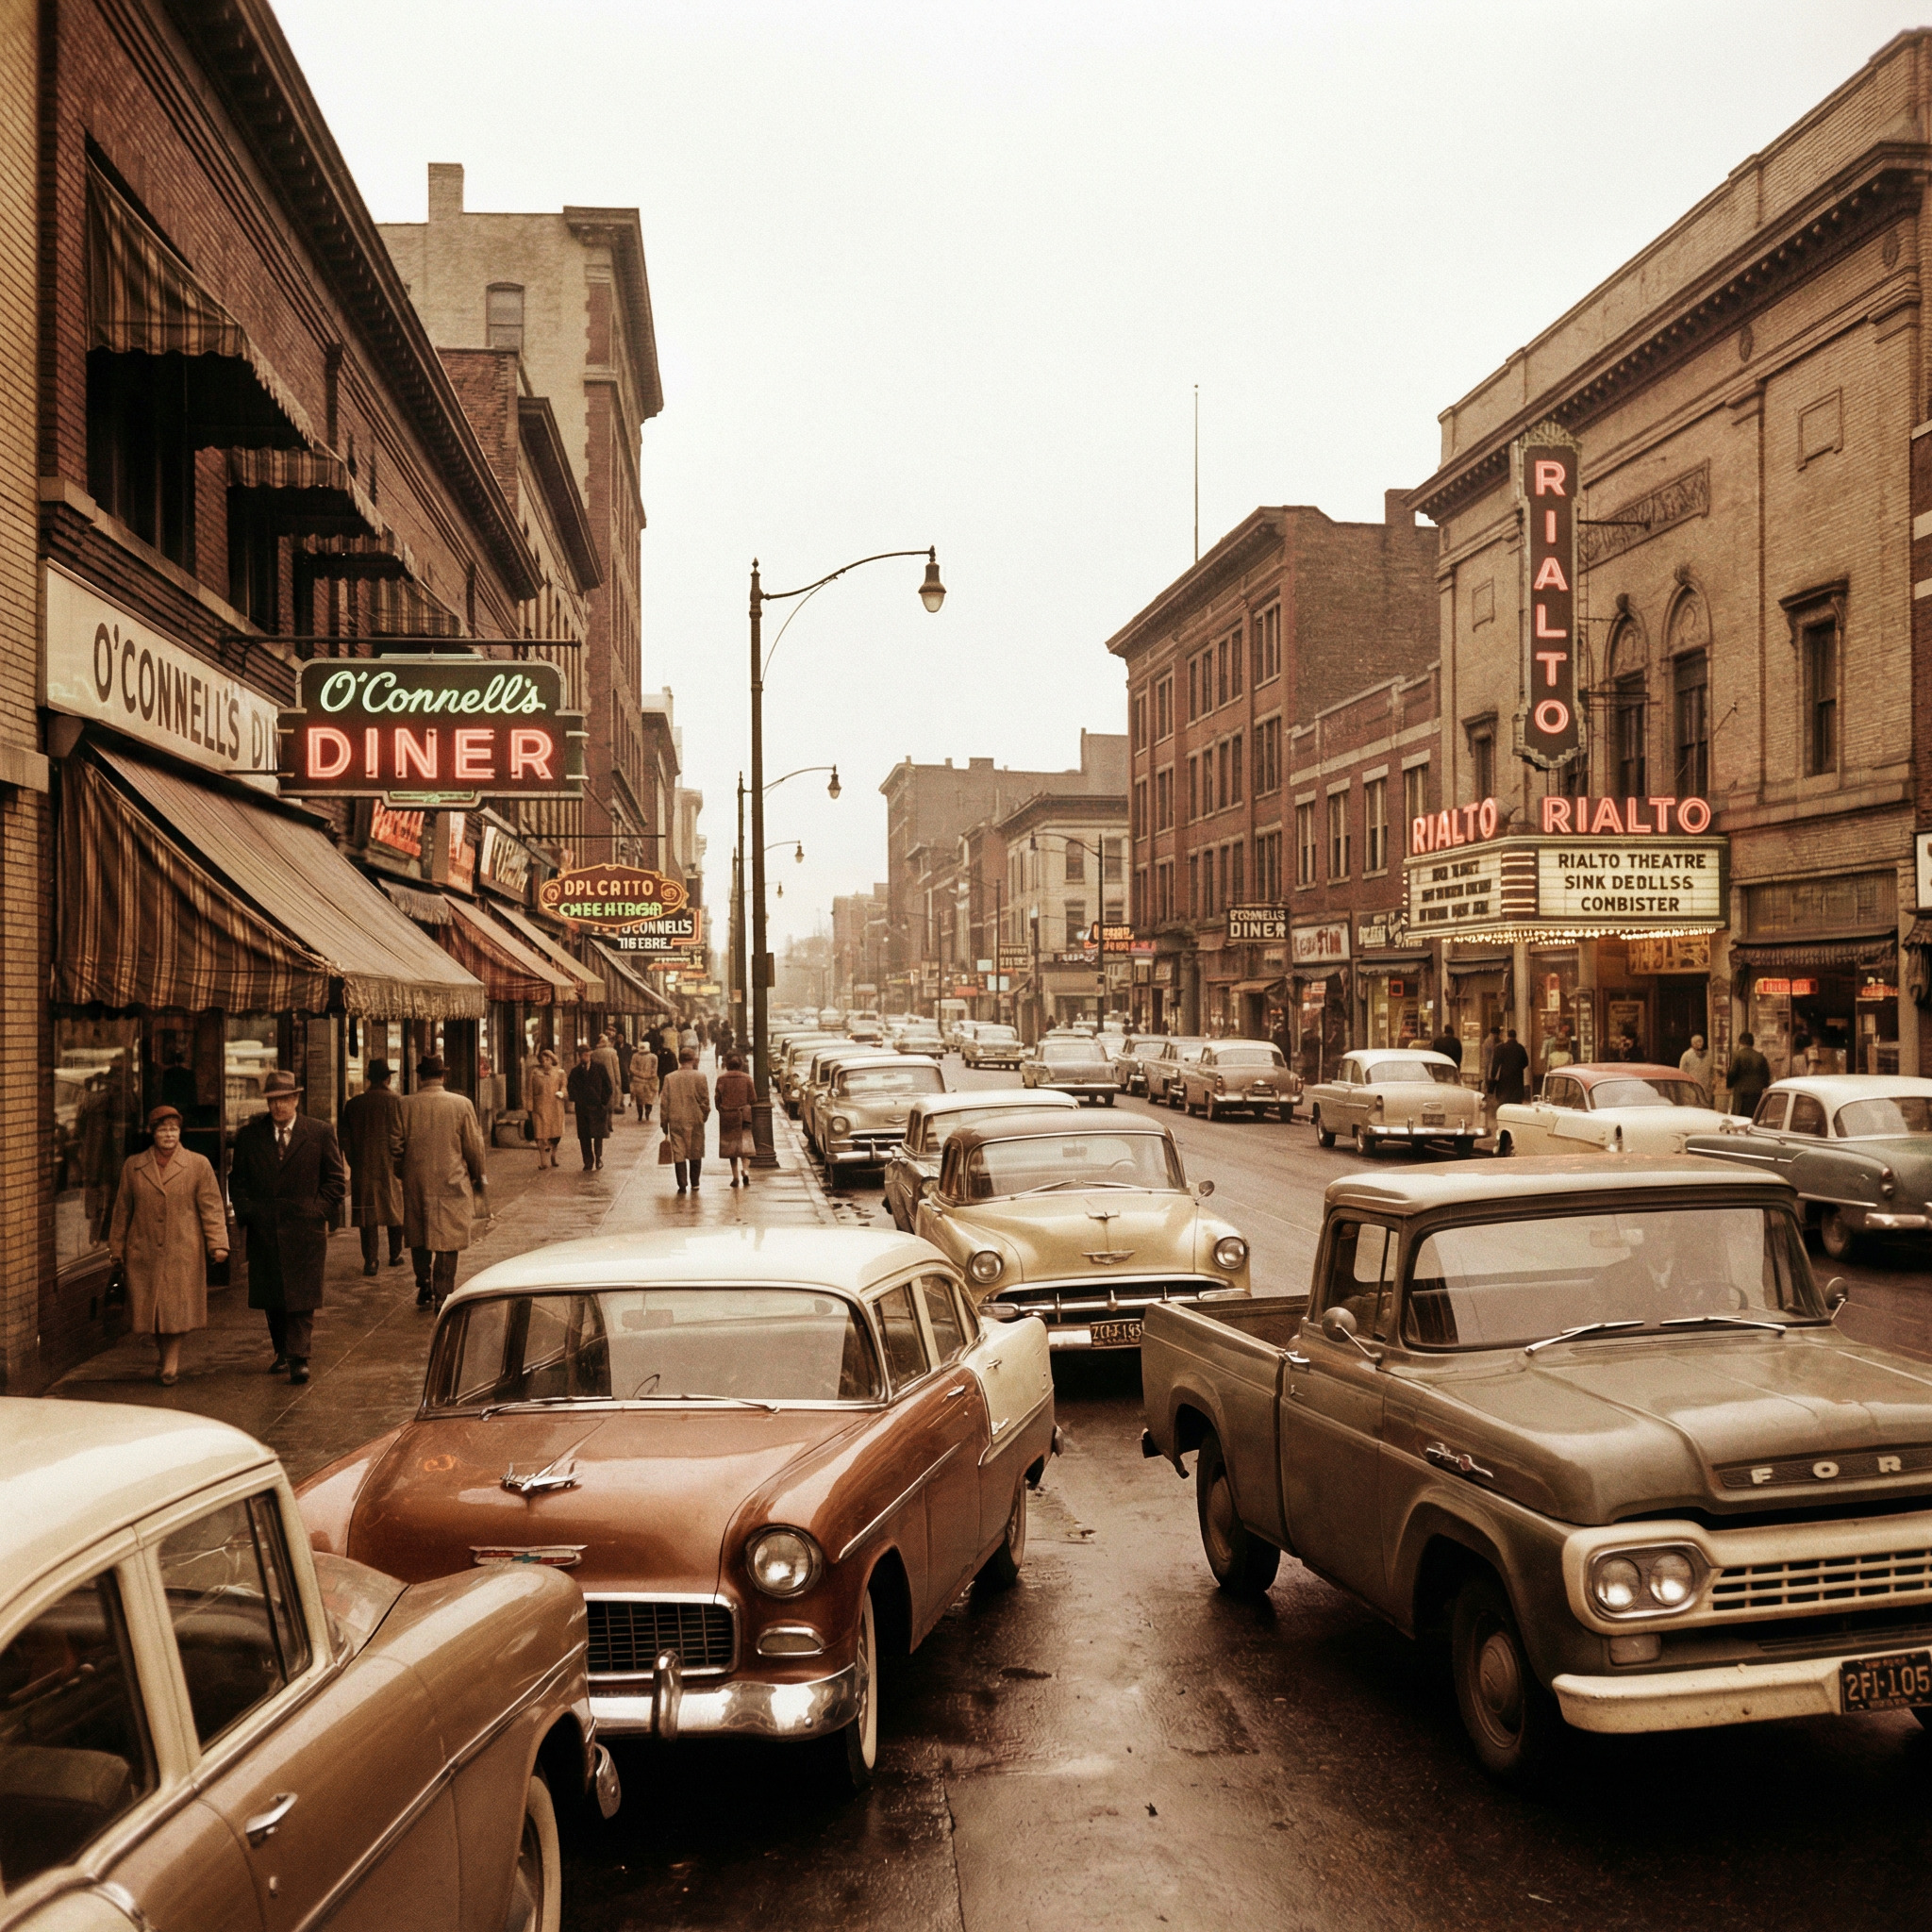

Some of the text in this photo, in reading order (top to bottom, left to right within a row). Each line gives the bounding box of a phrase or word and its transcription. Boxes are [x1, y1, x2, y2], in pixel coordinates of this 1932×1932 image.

[1533, 460, 1569, 734] RIALTO
[93, 622, 240, 761] O'CONNELL'S
[320, 670, 546, 714] O'Connell's
[308, 726, 554, 779] DINER
[1412, 797, 1497, 854] RIALTO
[1542, 796, 1712, 834] RIALTO
[1558, 853, 1707, 869] RIALTO THEATRE
[1565, 874, 1606, 890] SINK
[1230, 922, 1286, 938] DINER
